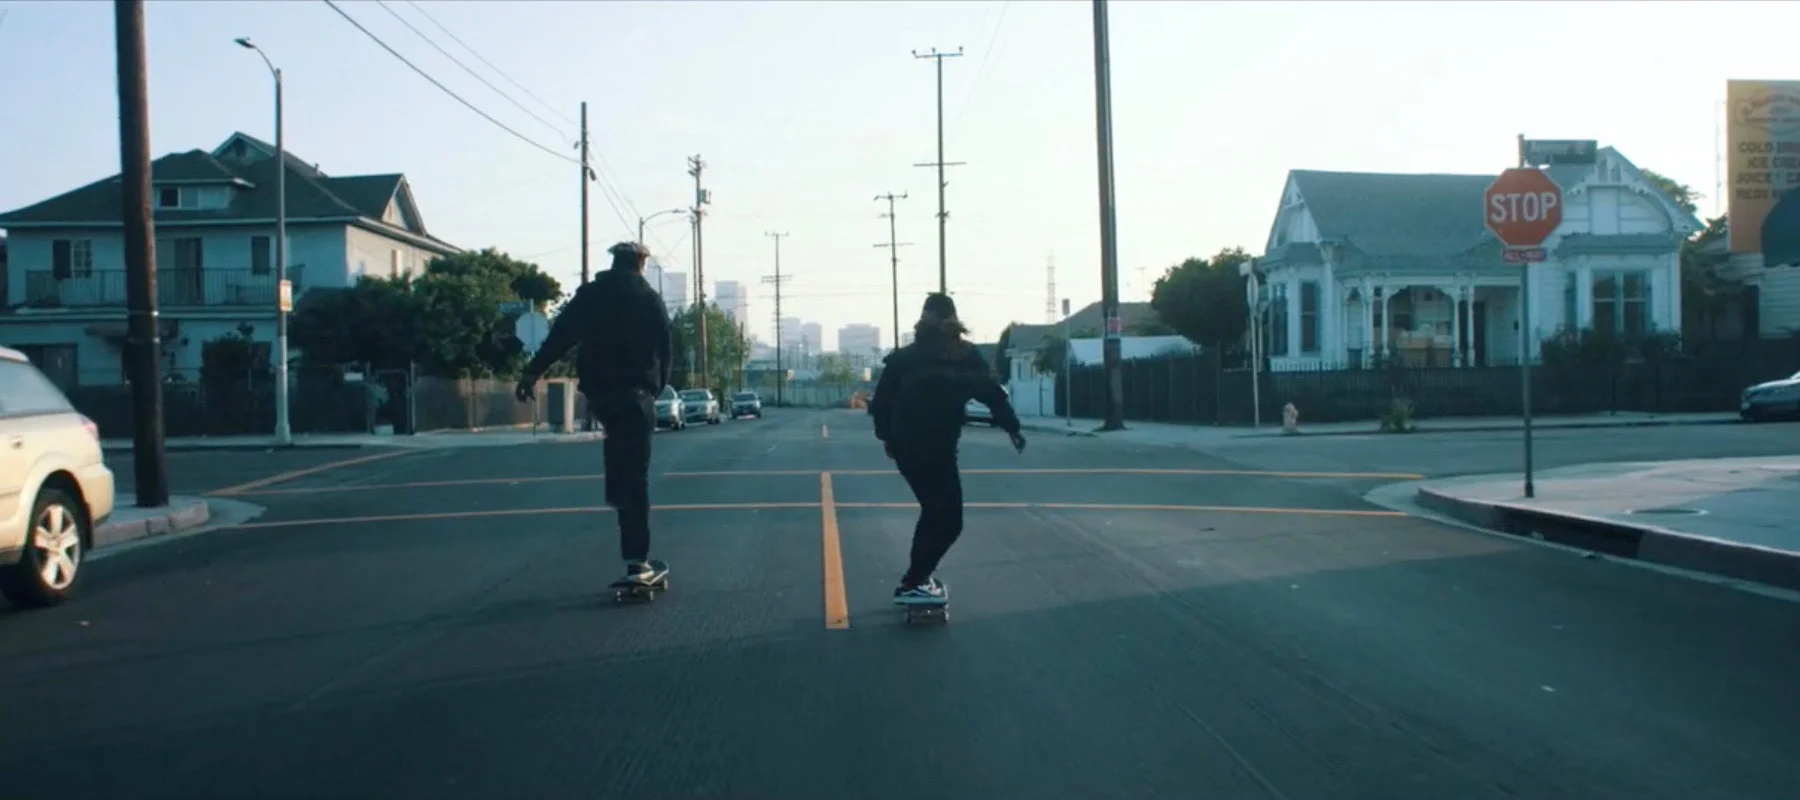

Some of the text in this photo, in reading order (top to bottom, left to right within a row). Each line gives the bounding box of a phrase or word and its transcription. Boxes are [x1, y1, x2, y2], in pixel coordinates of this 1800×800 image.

[1738, 142, 1773, 153] COLD
[1747, 156, 1768, 168] ICE
[1490, 192, 1556, 221] STOP
